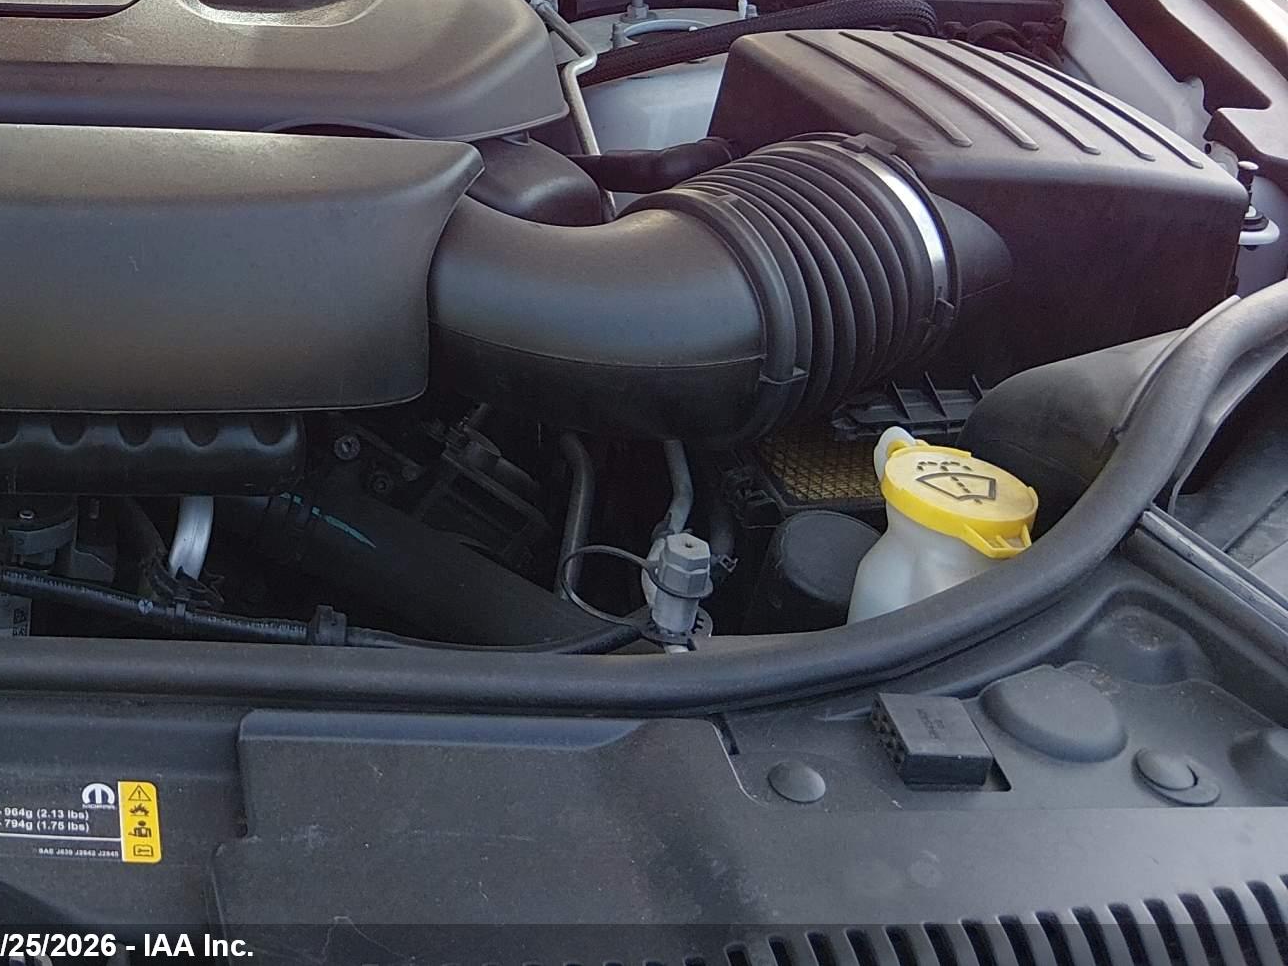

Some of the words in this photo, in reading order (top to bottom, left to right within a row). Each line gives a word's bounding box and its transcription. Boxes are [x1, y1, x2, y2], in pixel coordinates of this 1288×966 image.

[4, 807, 33, 819] 964g
[37, 808, 64, 820] (2.13
[67, 809, 90, 821] lbs)
[4, 819, 33, 831] 794g
[37, 820, 64, 832] (1.75
[67, 821, 90, 833] lbs)
